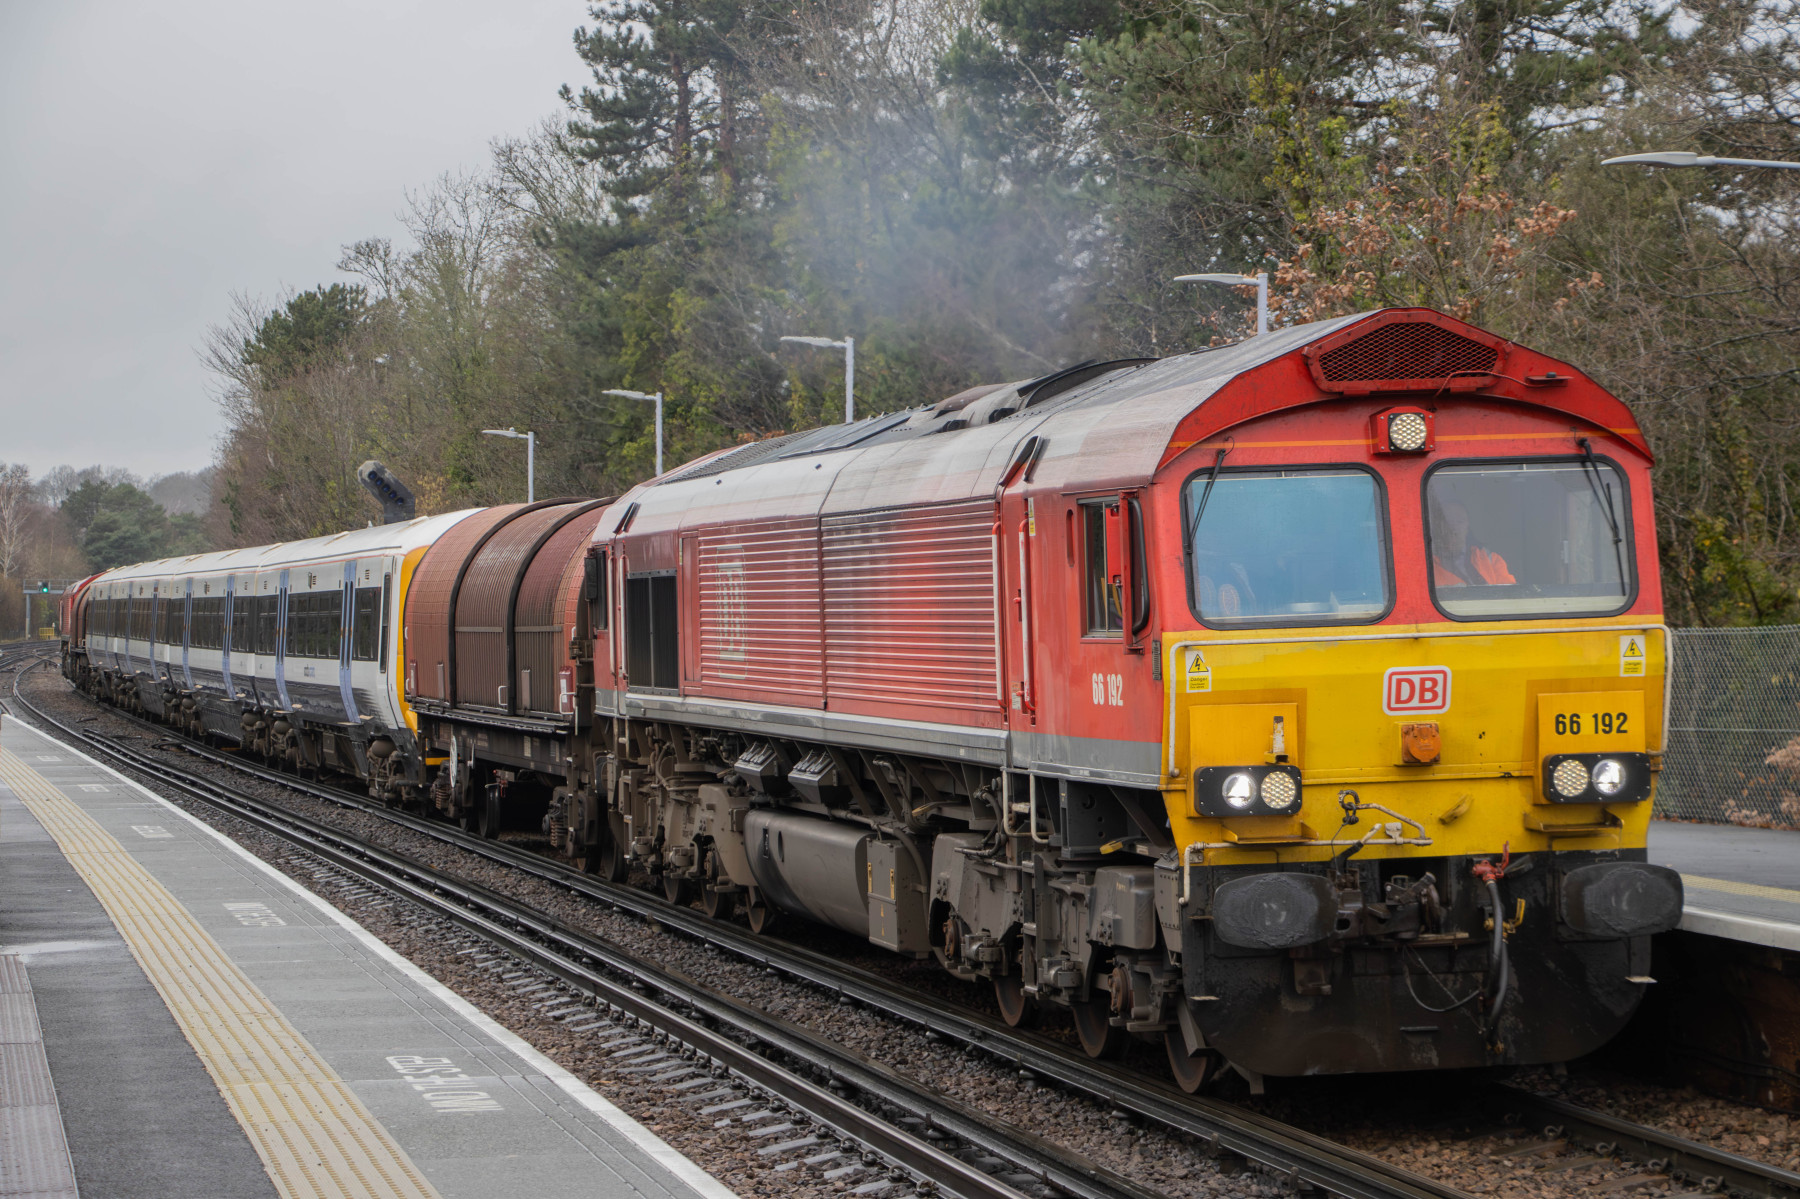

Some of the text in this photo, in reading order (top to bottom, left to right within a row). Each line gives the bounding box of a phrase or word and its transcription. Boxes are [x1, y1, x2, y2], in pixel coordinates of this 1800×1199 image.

[1092, 672, 1124, 706] 66 192
[1394, 676, 1440, 705] DB
[1555, 712, 1628, 735] 66 192
[385, 1055, 462, 1074] STEP
[403, 1074, 480, 1091] THE
